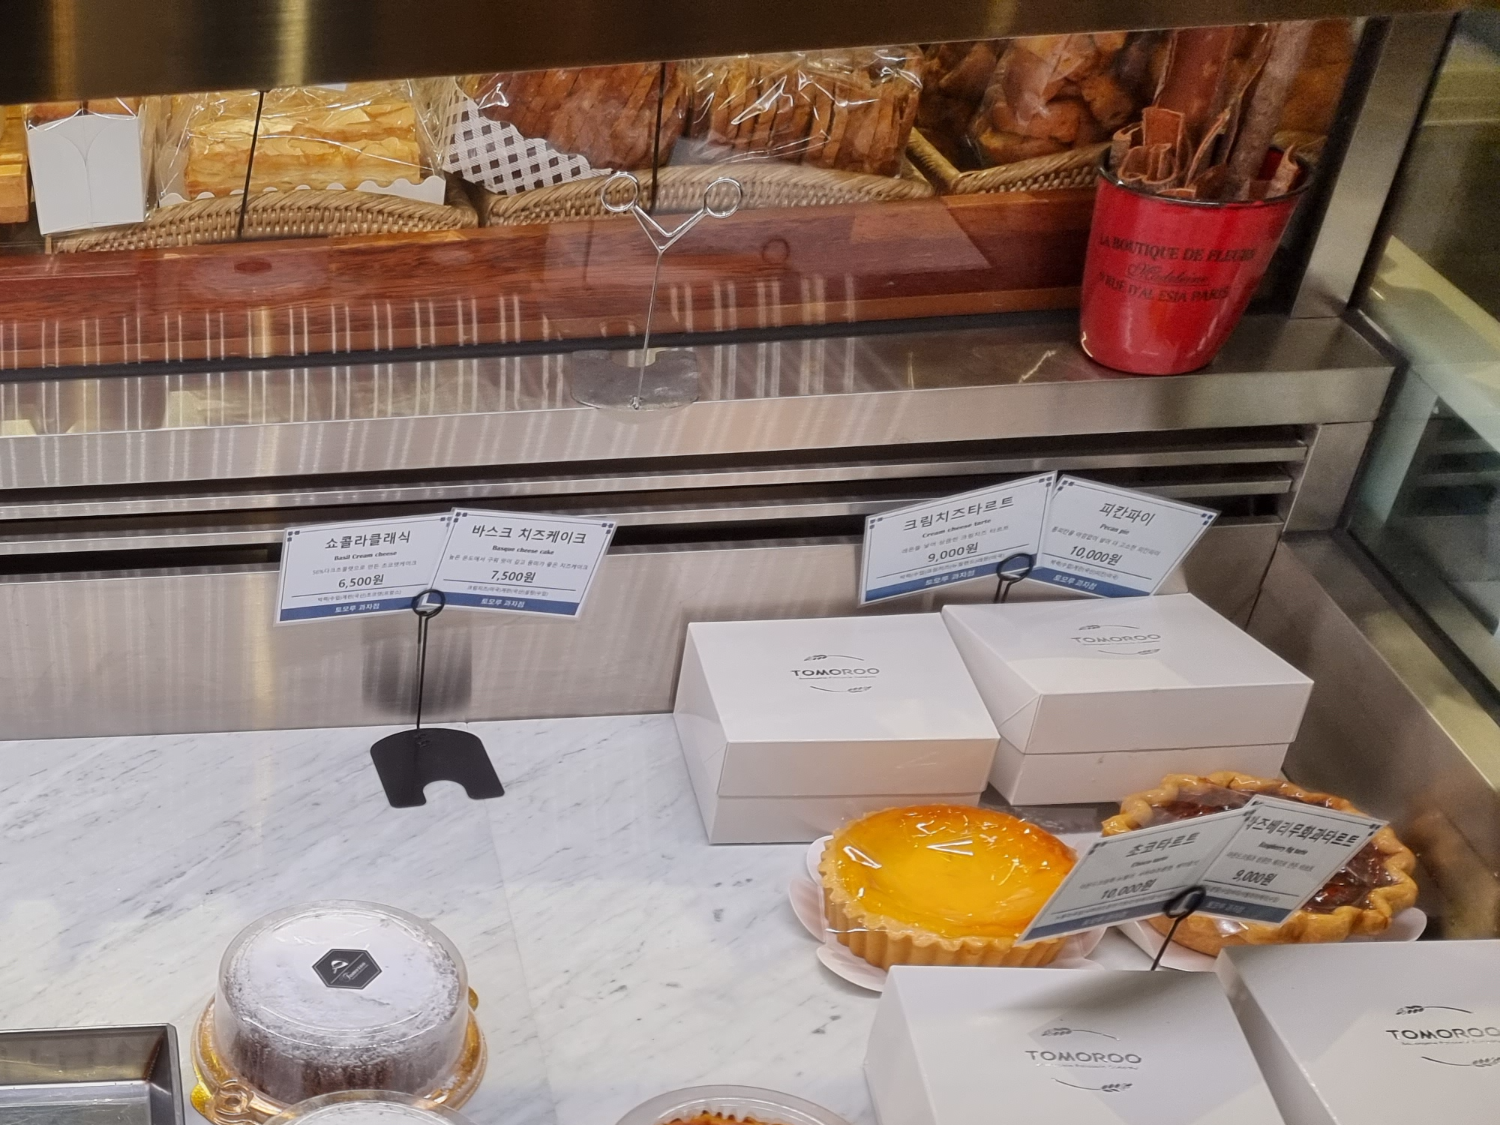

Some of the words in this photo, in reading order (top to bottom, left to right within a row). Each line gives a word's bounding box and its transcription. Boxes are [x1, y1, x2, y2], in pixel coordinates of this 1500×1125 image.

[1112, 237, 1179, 260] BOUTIQUE
[1182, 248, 1204, 261] DE
[903, 496, 1014, 531] 크림치즈타르트
[1099, 502, 1156, 527] 피칸파이
[472, 525, 513, 539] 바스크
[518, 528, 587, 545] 치즈케이크
[922, 530, 945, 538] Cream
[947, 523, 972, 532] cheese
[1099, 523, 1119, 533] Pecan
[325, 530, 411, 549] 쇼콜라클래식
[927, 541, 979, 563] 9,000원
[1070, 545, 1123, 567] 10,000원
[338, 574, 384, 589] 6,500원
[491, 570, 537, 584] 7,500원
[925, 576, 949, 586] 토모루
[951, 570, 976, 580] 과자점
[1053, 574, 1076, 585] 토모루
[1078, 579, 1098, 591] 과자점
[334, 605, 357, 613] 토모루
[358, 603, 380, 611] 과자점
[480, 598, 502, 606] 토모루
[503, 600, 526, 608] 과자점
[1071, 634, 1161, 643] TOMOROO
[790, 668, 880, 677] TOMOROO
[1125, 832, 1201, 858] 초코타르트
[1233, 869, 1278, 886] 9,000원
[1101, 878, 1157, 900] 10,000원
[1385, 1027, 1500, 1040] TOMOROO
[1024, 1050, 1142, 1064] TOMOROO
